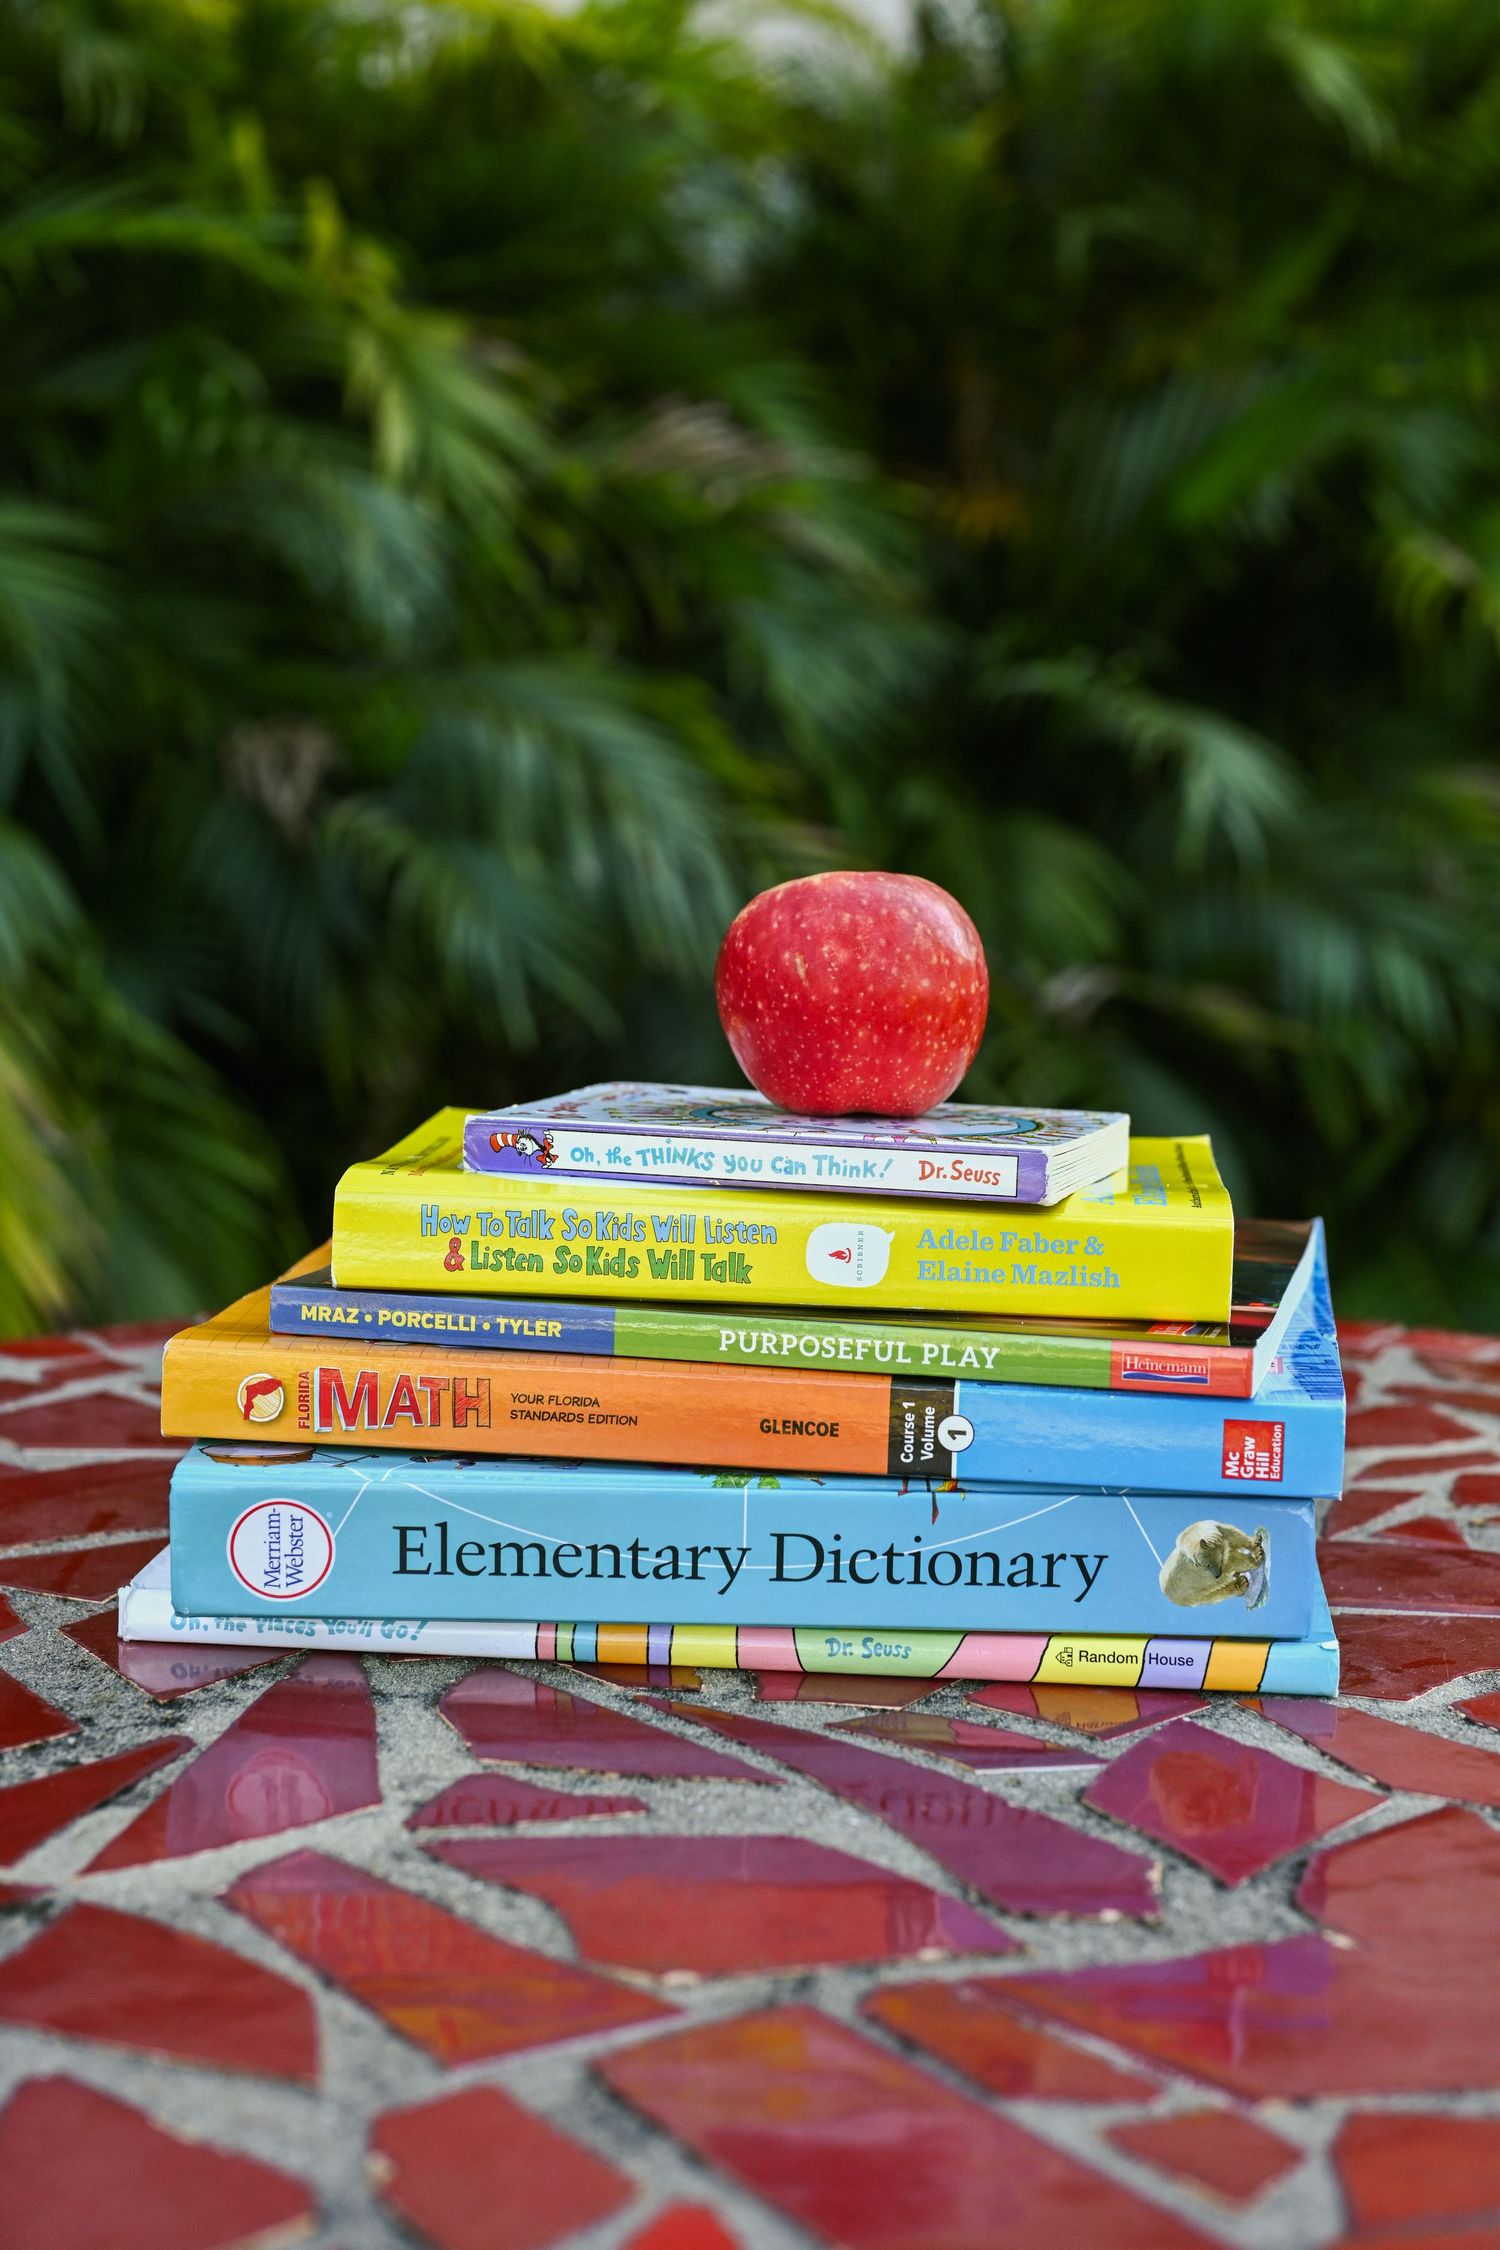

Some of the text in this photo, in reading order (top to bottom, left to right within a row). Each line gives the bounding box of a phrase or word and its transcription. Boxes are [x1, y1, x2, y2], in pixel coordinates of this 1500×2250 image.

[570, 1145, 600, 1168] Oh,
[605, 1145, 633, 1168] the
[722, 1152, 765, 1175] you
[770, 1151, 807, 1176] Can
[813, 1154, 893, 1180] Think!
[918, 1159, 1001, 1187] Dr. Seuss
[421, 1204, 777, 1245] How To Talk So Kids Will Listen
[917, 1228, 1105, 1256] Adele Faber &
[443, 1237, 752, 1284] & Listen So Kids Will Talk
[856, 1230, 864, 1282] SCRIBNER
[917, 1259, 1120, 1289] Elaine Mazlish
[301, 1306, 562, 1338] MRAZ PORCELLI TYLER
[719, 1330, 1000, 1369] PURPOSEFUL PLAY
[1125, 1356, 1207, 1375] Heinemann
[298, 1371, 310, 1429] FLORIDA
[314, 1366, 491, 1433] MATH
[510, 1393, 601, 1408] YOUR FLORIDA
[510, 1410, 638, 1427] STANDARDS EDITION
[759, 1418, 839, 1438] GLENCOE
[900, 1401, 916, 1463] Course 1
[920, 1406, 967, 1460] Volume 1
[1225, 1451, 1240, 1477] Mc
[1240, 1435, 1255, 1479] Graw
[1255, 1451, 1270, 1479] Hill
[1270, 1424, 1282, 1479] Education
[264, 1508, 281, 1590] Merriam-
[284, 1514, 304, 1589] Webster
[391, 1521, 1109, 1602] Elementary Dictionary
[380, 1620, 429, 1641] Go!
[825, 1637, 912, 1660] Dr. Seuss
[1079, 1649, 1195, 1668] Random House
